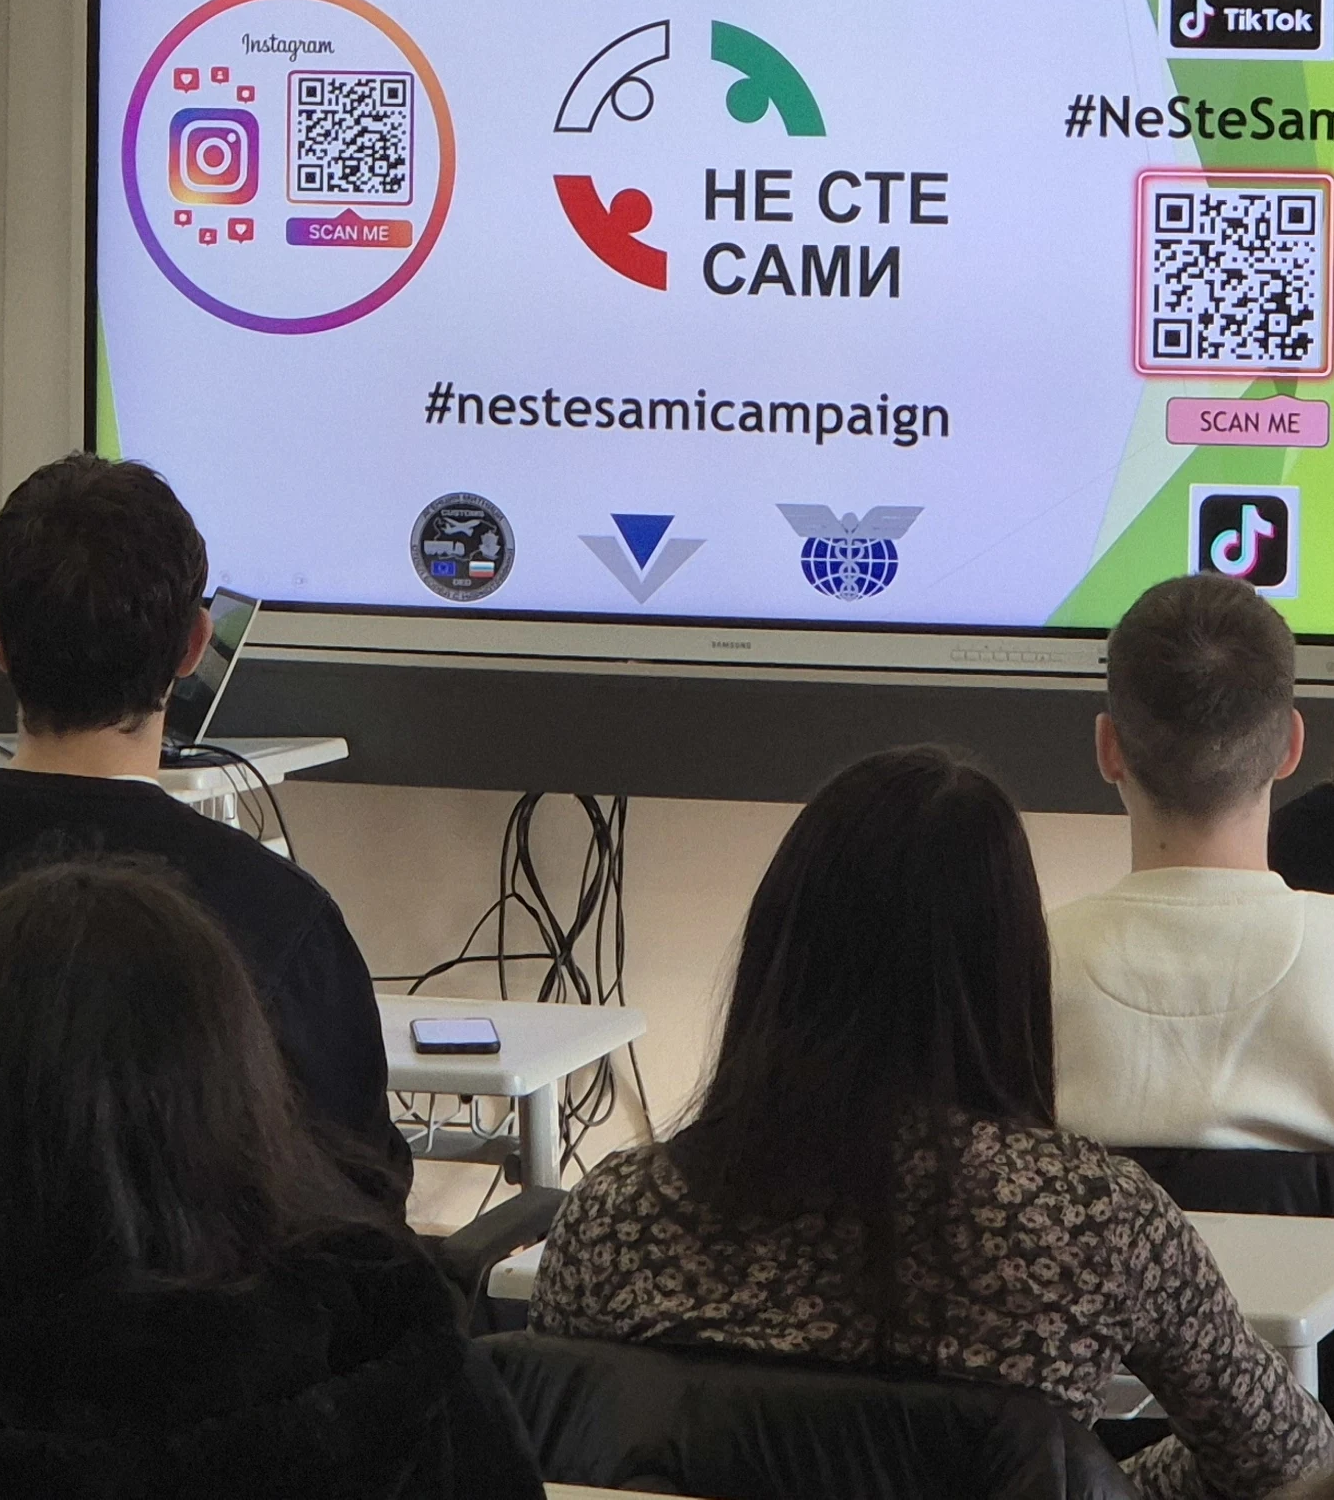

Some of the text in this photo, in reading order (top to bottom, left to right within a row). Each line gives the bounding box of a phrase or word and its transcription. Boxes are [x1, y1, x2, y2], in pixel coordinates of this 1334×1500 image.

[1222, 7, 1313, 33] TikTok
[241, 33, 335, 62] Instagram
[703, 167, 949, 226] НЕ СТЕ
[308, 224, 390, 242] SCAN ME
[701, 241, 901, 299] САМИ
[423, 381, 950, 446] #nestesamicampaign
[1200, 411, 1301, 434] SCAN ME
